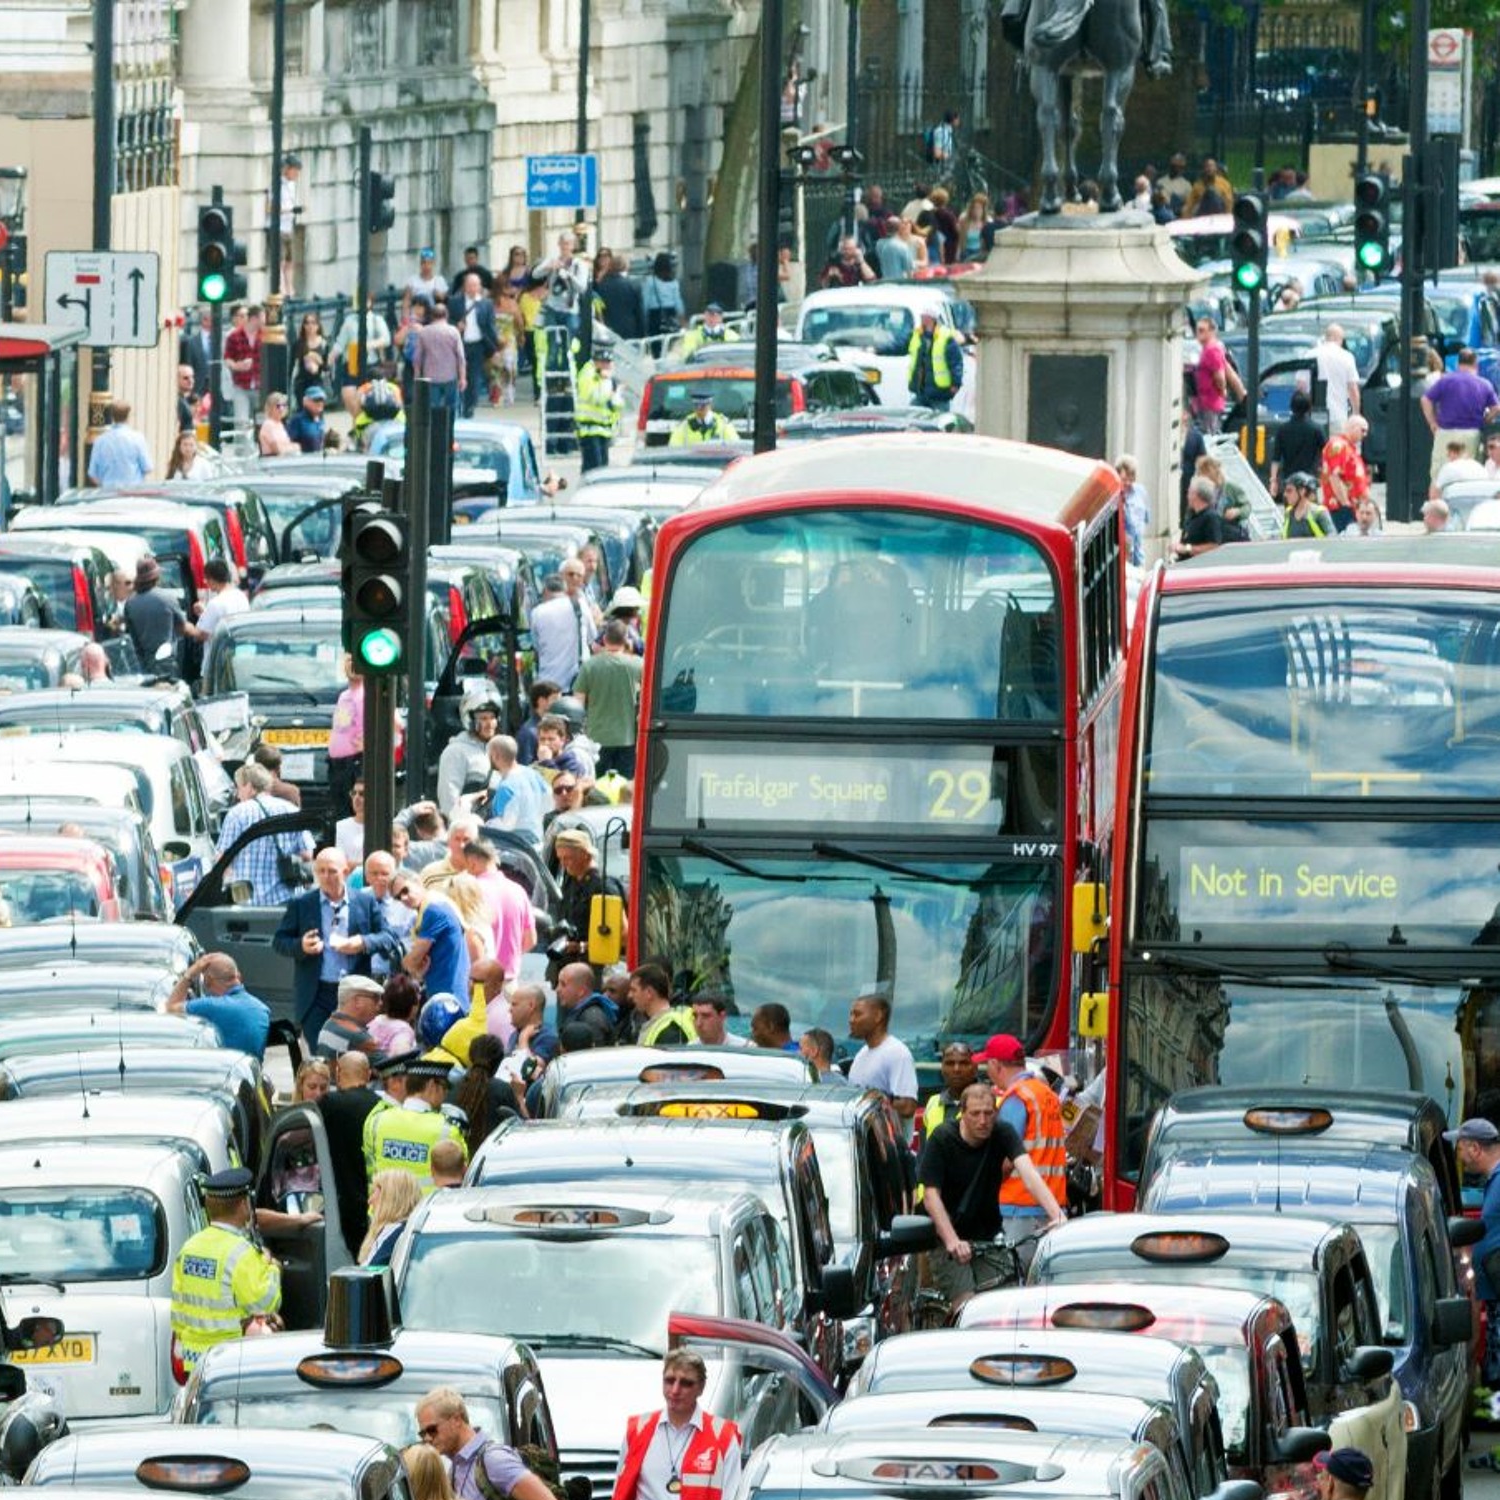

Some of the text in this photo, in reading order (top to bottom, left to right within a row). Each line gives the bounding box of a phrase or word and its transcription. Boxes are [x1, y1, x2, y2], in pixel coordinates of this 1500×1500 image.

[701, 770, 889, 808] Trafalgar Square
[926, 769, 991, 820] 29
[1012, 842, 1058, 858] HV 97
[1190, 862, 1399, 898] Not in Service
[383, 1146, 427, 1161] POLICE
[537, 1210, 600, 1224] TAXI
[183, 1261, 216, 1278] POLICE
[901, 1462, 977, 1482] TAXI
